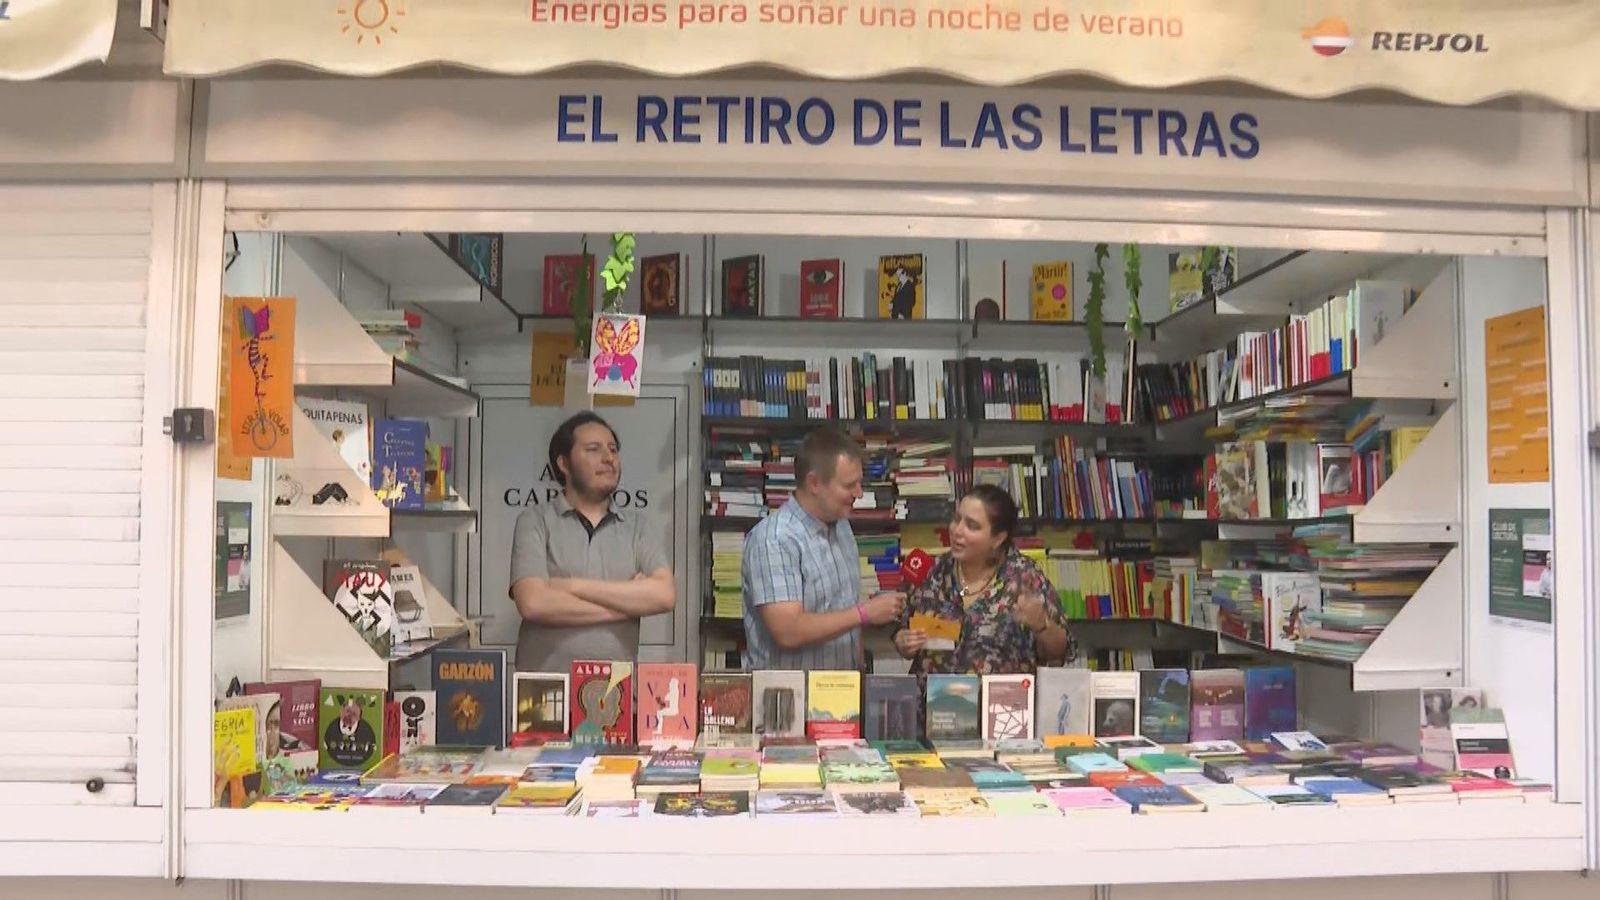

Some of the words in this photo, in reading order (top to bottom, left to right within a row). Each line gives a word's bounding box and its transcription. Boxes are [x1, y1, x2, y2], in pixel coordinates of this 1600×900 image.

[679, 4, 747, 29] para
[760, 0, 849, 24] soñar
[860, 7, 916, 27] una
[928, 4, 1021, 31] noche
[1033, 6, 1069, 32] de
[1081, 13, 1183, 38] verano
[1372, 31, 1489, 53] REPSOL
[558, 95, 618, 143] EL
[636, 96, 835, 146] RETIRO
[853, 98, 922, 148] DE
[940, 101, 1043, 152] LAS
[1060, 106, 1260, 159] LETRAS
[303, 408, 363, 425] QUITAPENAS
[504, 488, 648, 508] CAPOS
[391, 573, 414, 583] AMES
[440, 659, 495, 680] GARZÓN
[576, 664, 611, 675] ALDO
[214, 717, 245, 732] EGRIA
